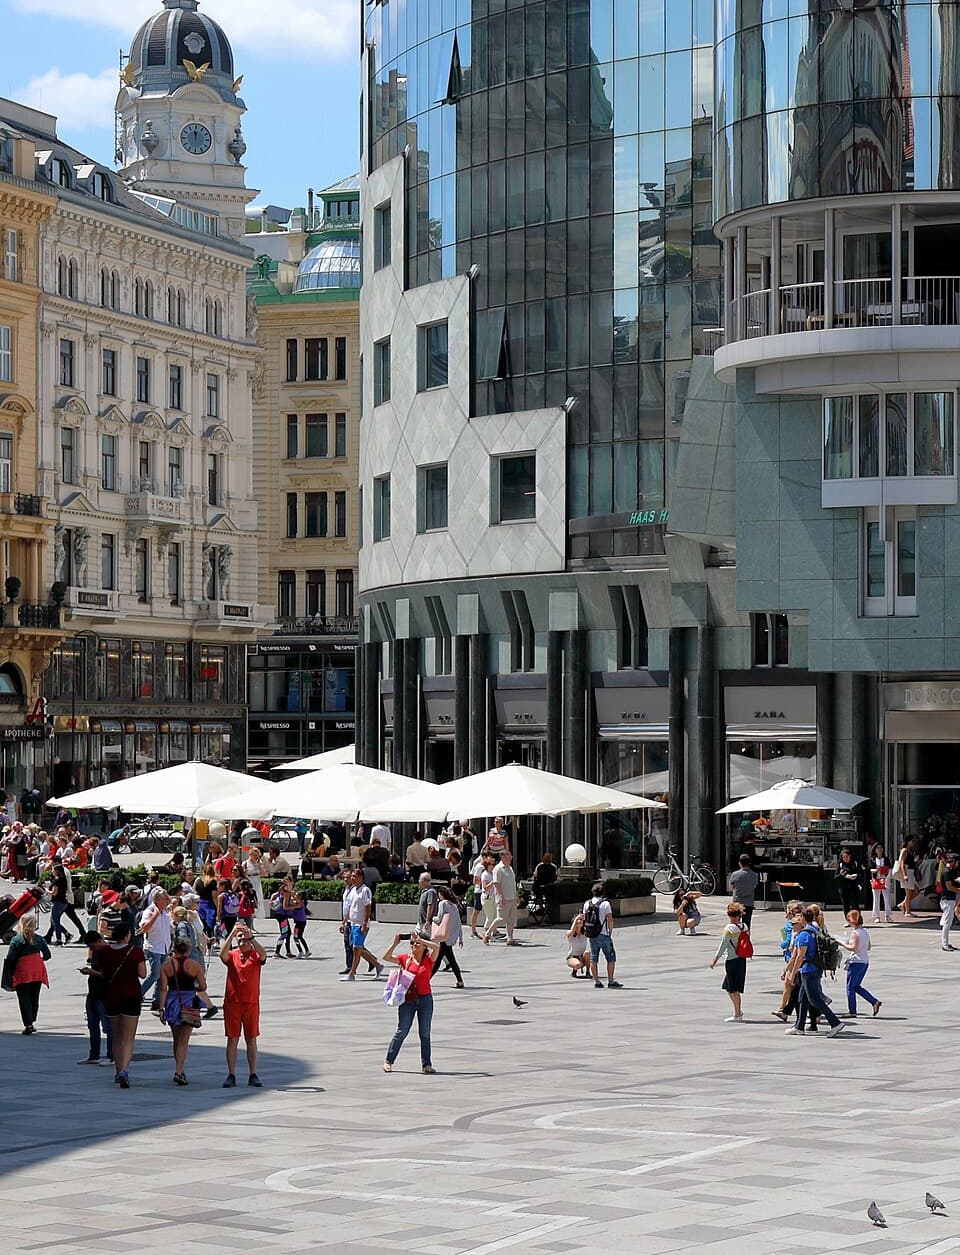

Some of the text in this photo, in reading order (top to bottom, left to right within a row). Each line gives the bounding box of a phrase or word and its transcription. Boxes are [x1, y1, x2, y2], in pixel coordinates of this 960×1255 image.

[629, 510, 656, 525] HAAS
[754, 711, 786, 719] ZARA
[4, 729, 41, 737] APOTHEKE
